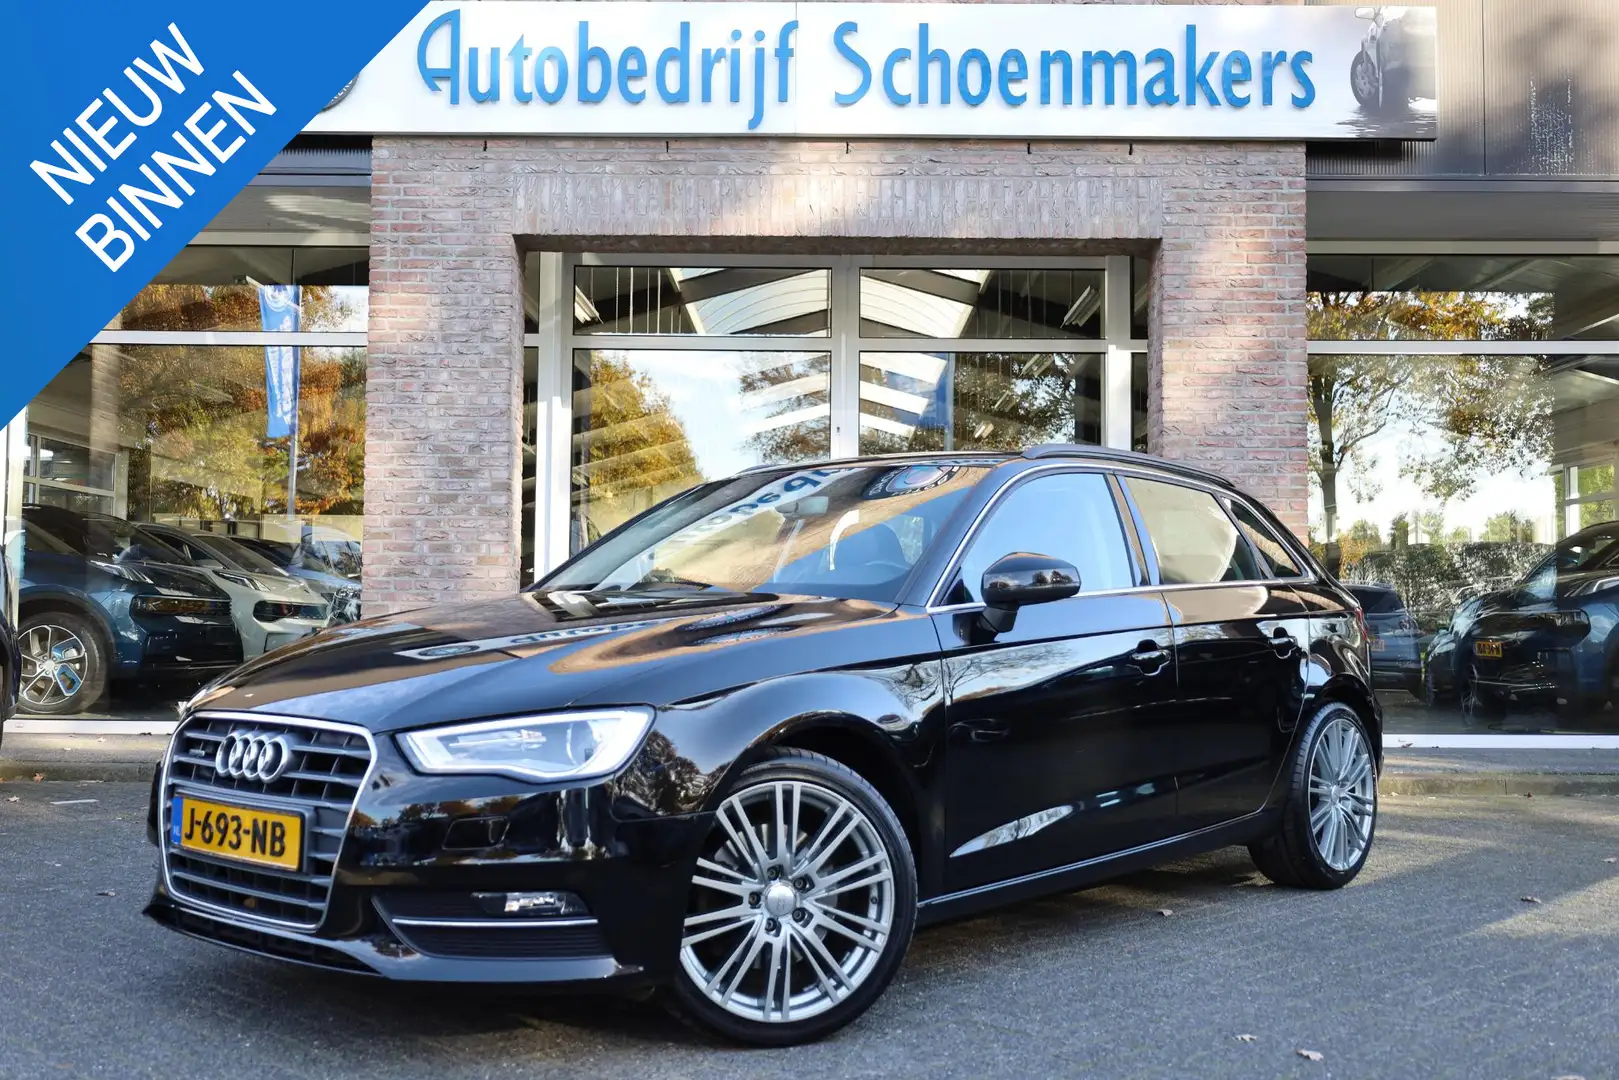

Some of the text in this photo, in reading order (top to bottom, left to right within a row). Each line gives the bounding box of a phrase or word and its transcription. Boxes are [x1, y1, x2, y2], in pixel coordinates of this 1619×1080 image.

[417, 9, 1316, 131] Autobedrijf Schoenmakers
[184, 807, 286, 857] J-693-NB
